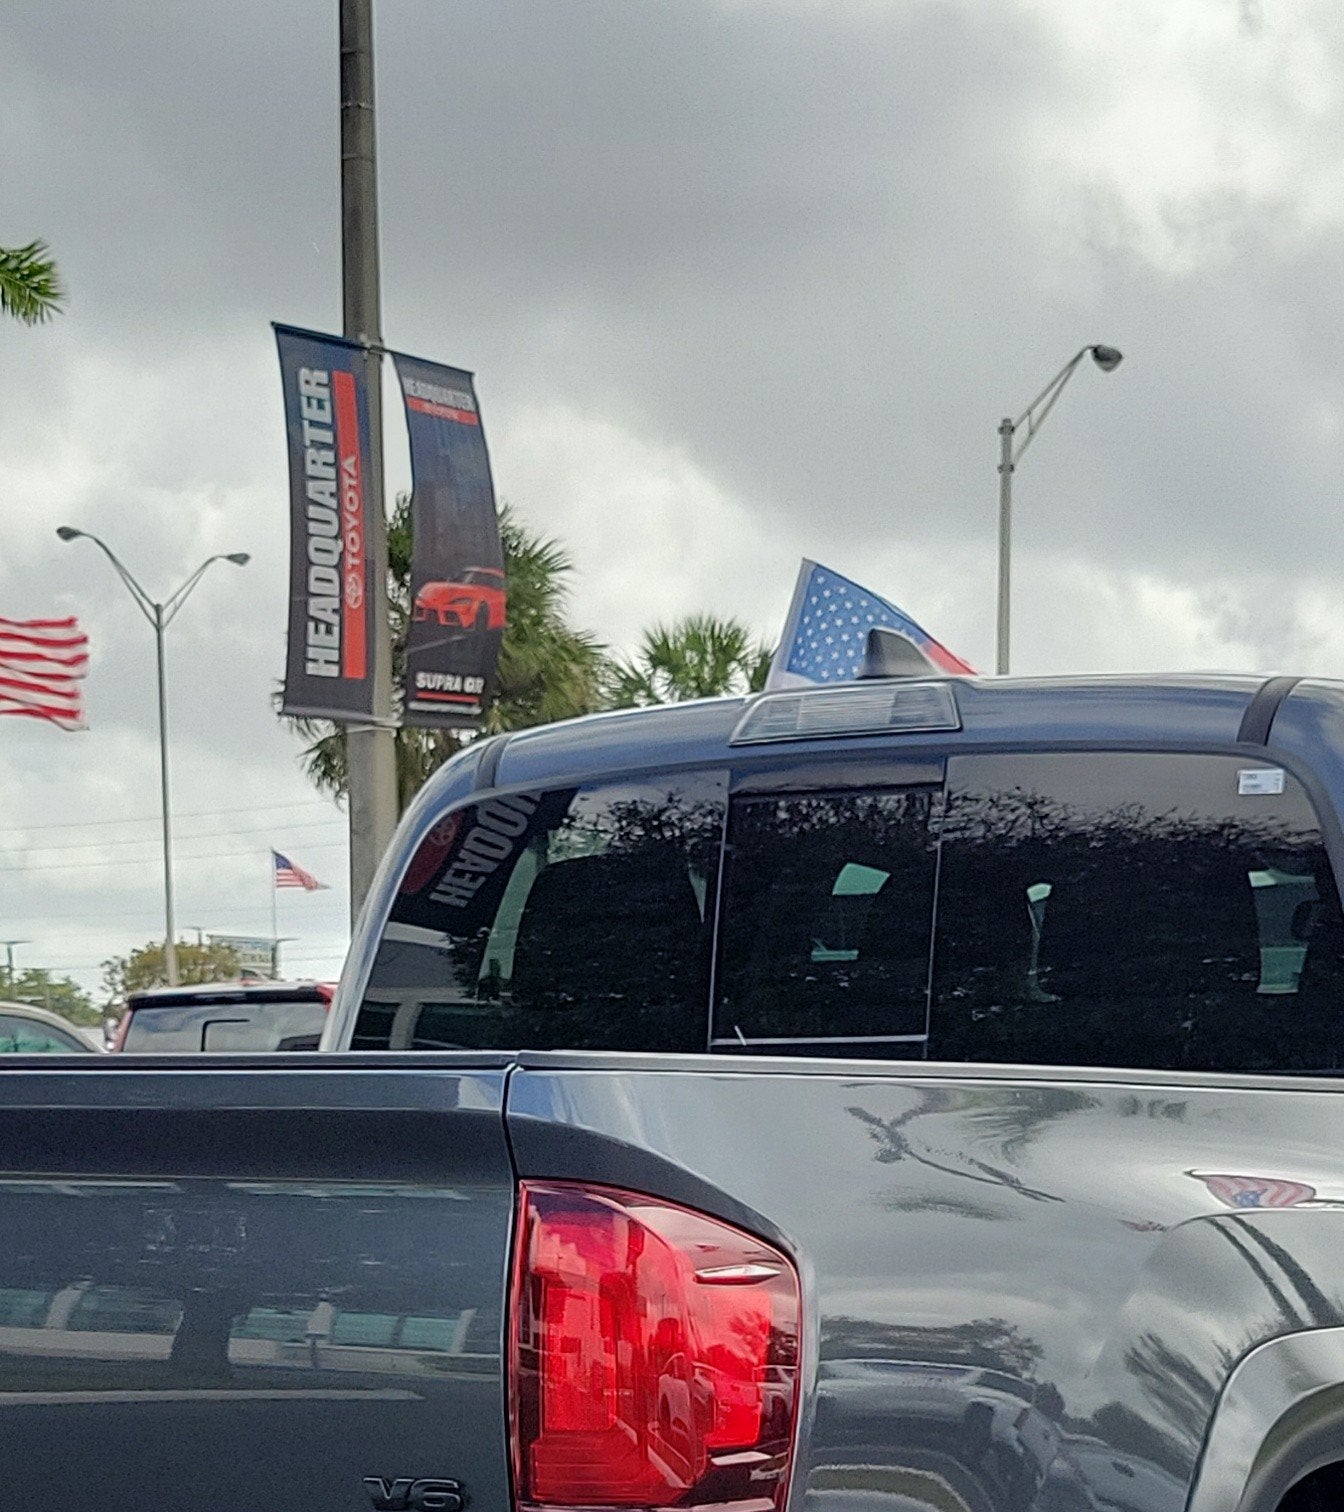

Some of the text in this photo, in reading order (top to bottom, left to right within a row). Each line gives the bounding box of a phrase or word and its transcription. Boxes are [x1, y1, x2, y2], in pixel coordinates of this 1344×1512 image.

[298, 367, 342, 679] HEADQUARTER
[344, 456, 364, 570] TOYOTA
[416, 671, 463, 692] SUPRA
[363, 1476, 464, 1512] V6
